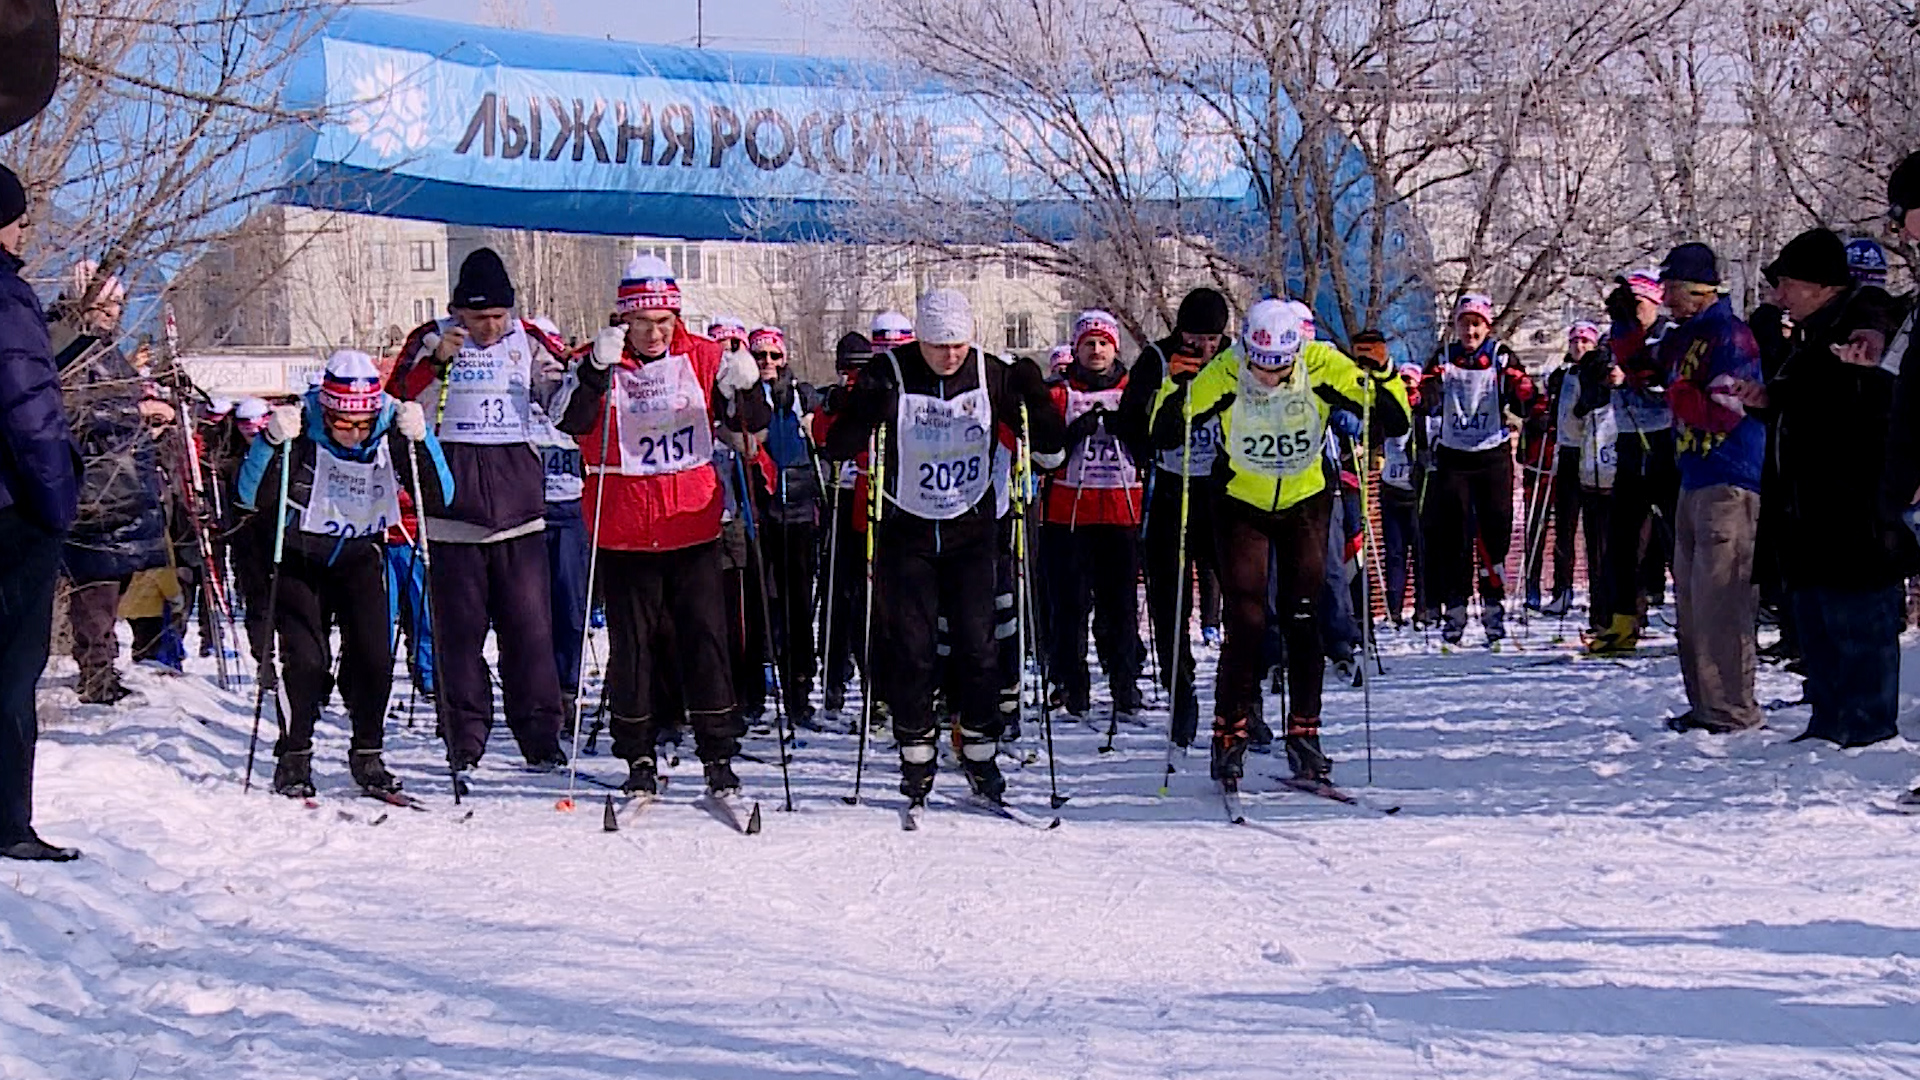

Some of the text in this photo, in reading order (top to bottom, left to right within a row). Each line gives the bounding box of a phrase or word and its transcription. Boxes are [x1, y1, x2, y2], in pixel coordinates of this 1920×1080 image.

[453, 92, 697, 167] ЛЫЖНЯ
[708, 105, 934, 176] РОССИИ
[480, 398, 504, 423] 13
[1451, 412, 1490, 430] 2047
[639, 425, 694, 465] 2157
[1242, 429, 1311, 458] 2265
[919, 455, 981, 491] 2028
